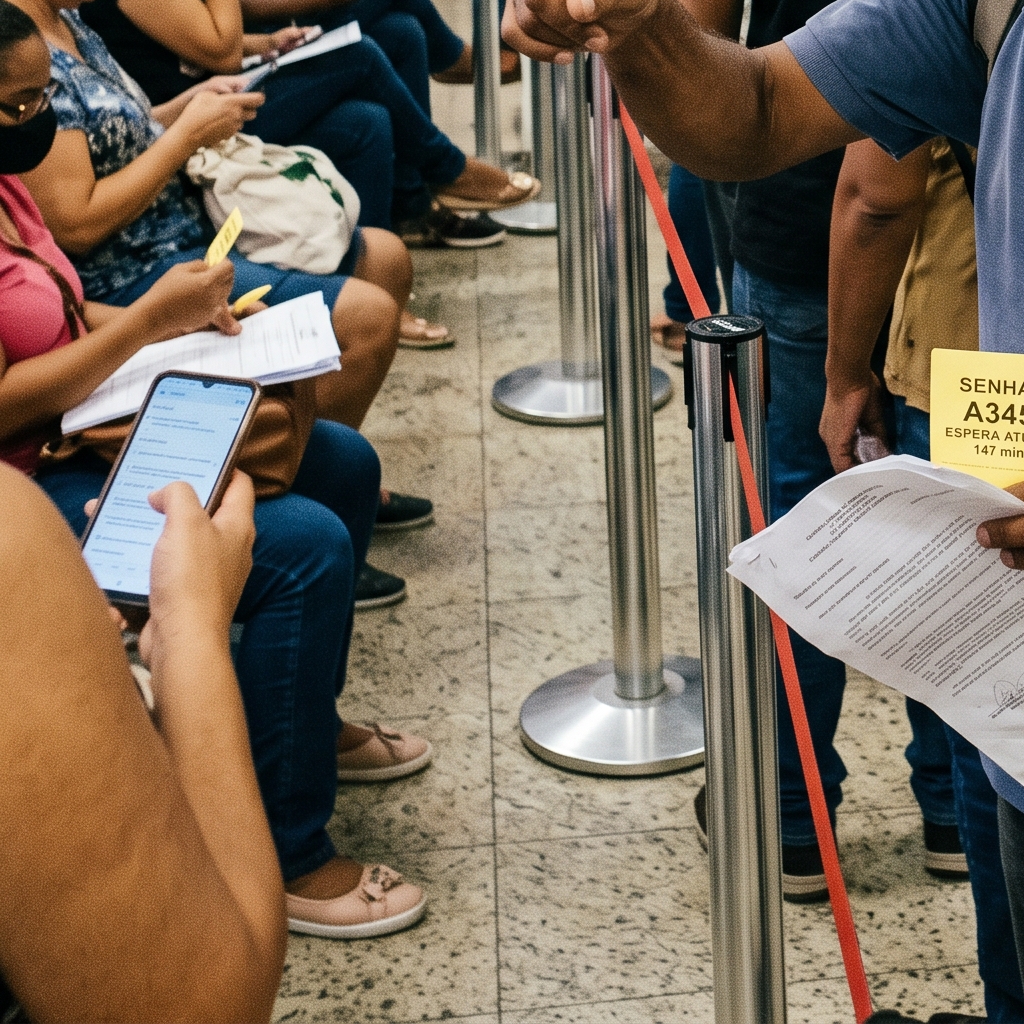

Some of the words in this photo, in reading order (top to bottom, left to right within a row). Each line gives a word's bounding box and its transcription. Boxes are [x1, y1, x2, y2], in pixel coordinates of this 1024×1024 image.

[945, 427, 1001, 441] ESPERA
[974, 444, 996, 455] 147
[1000, 446, 1024, 458] min
